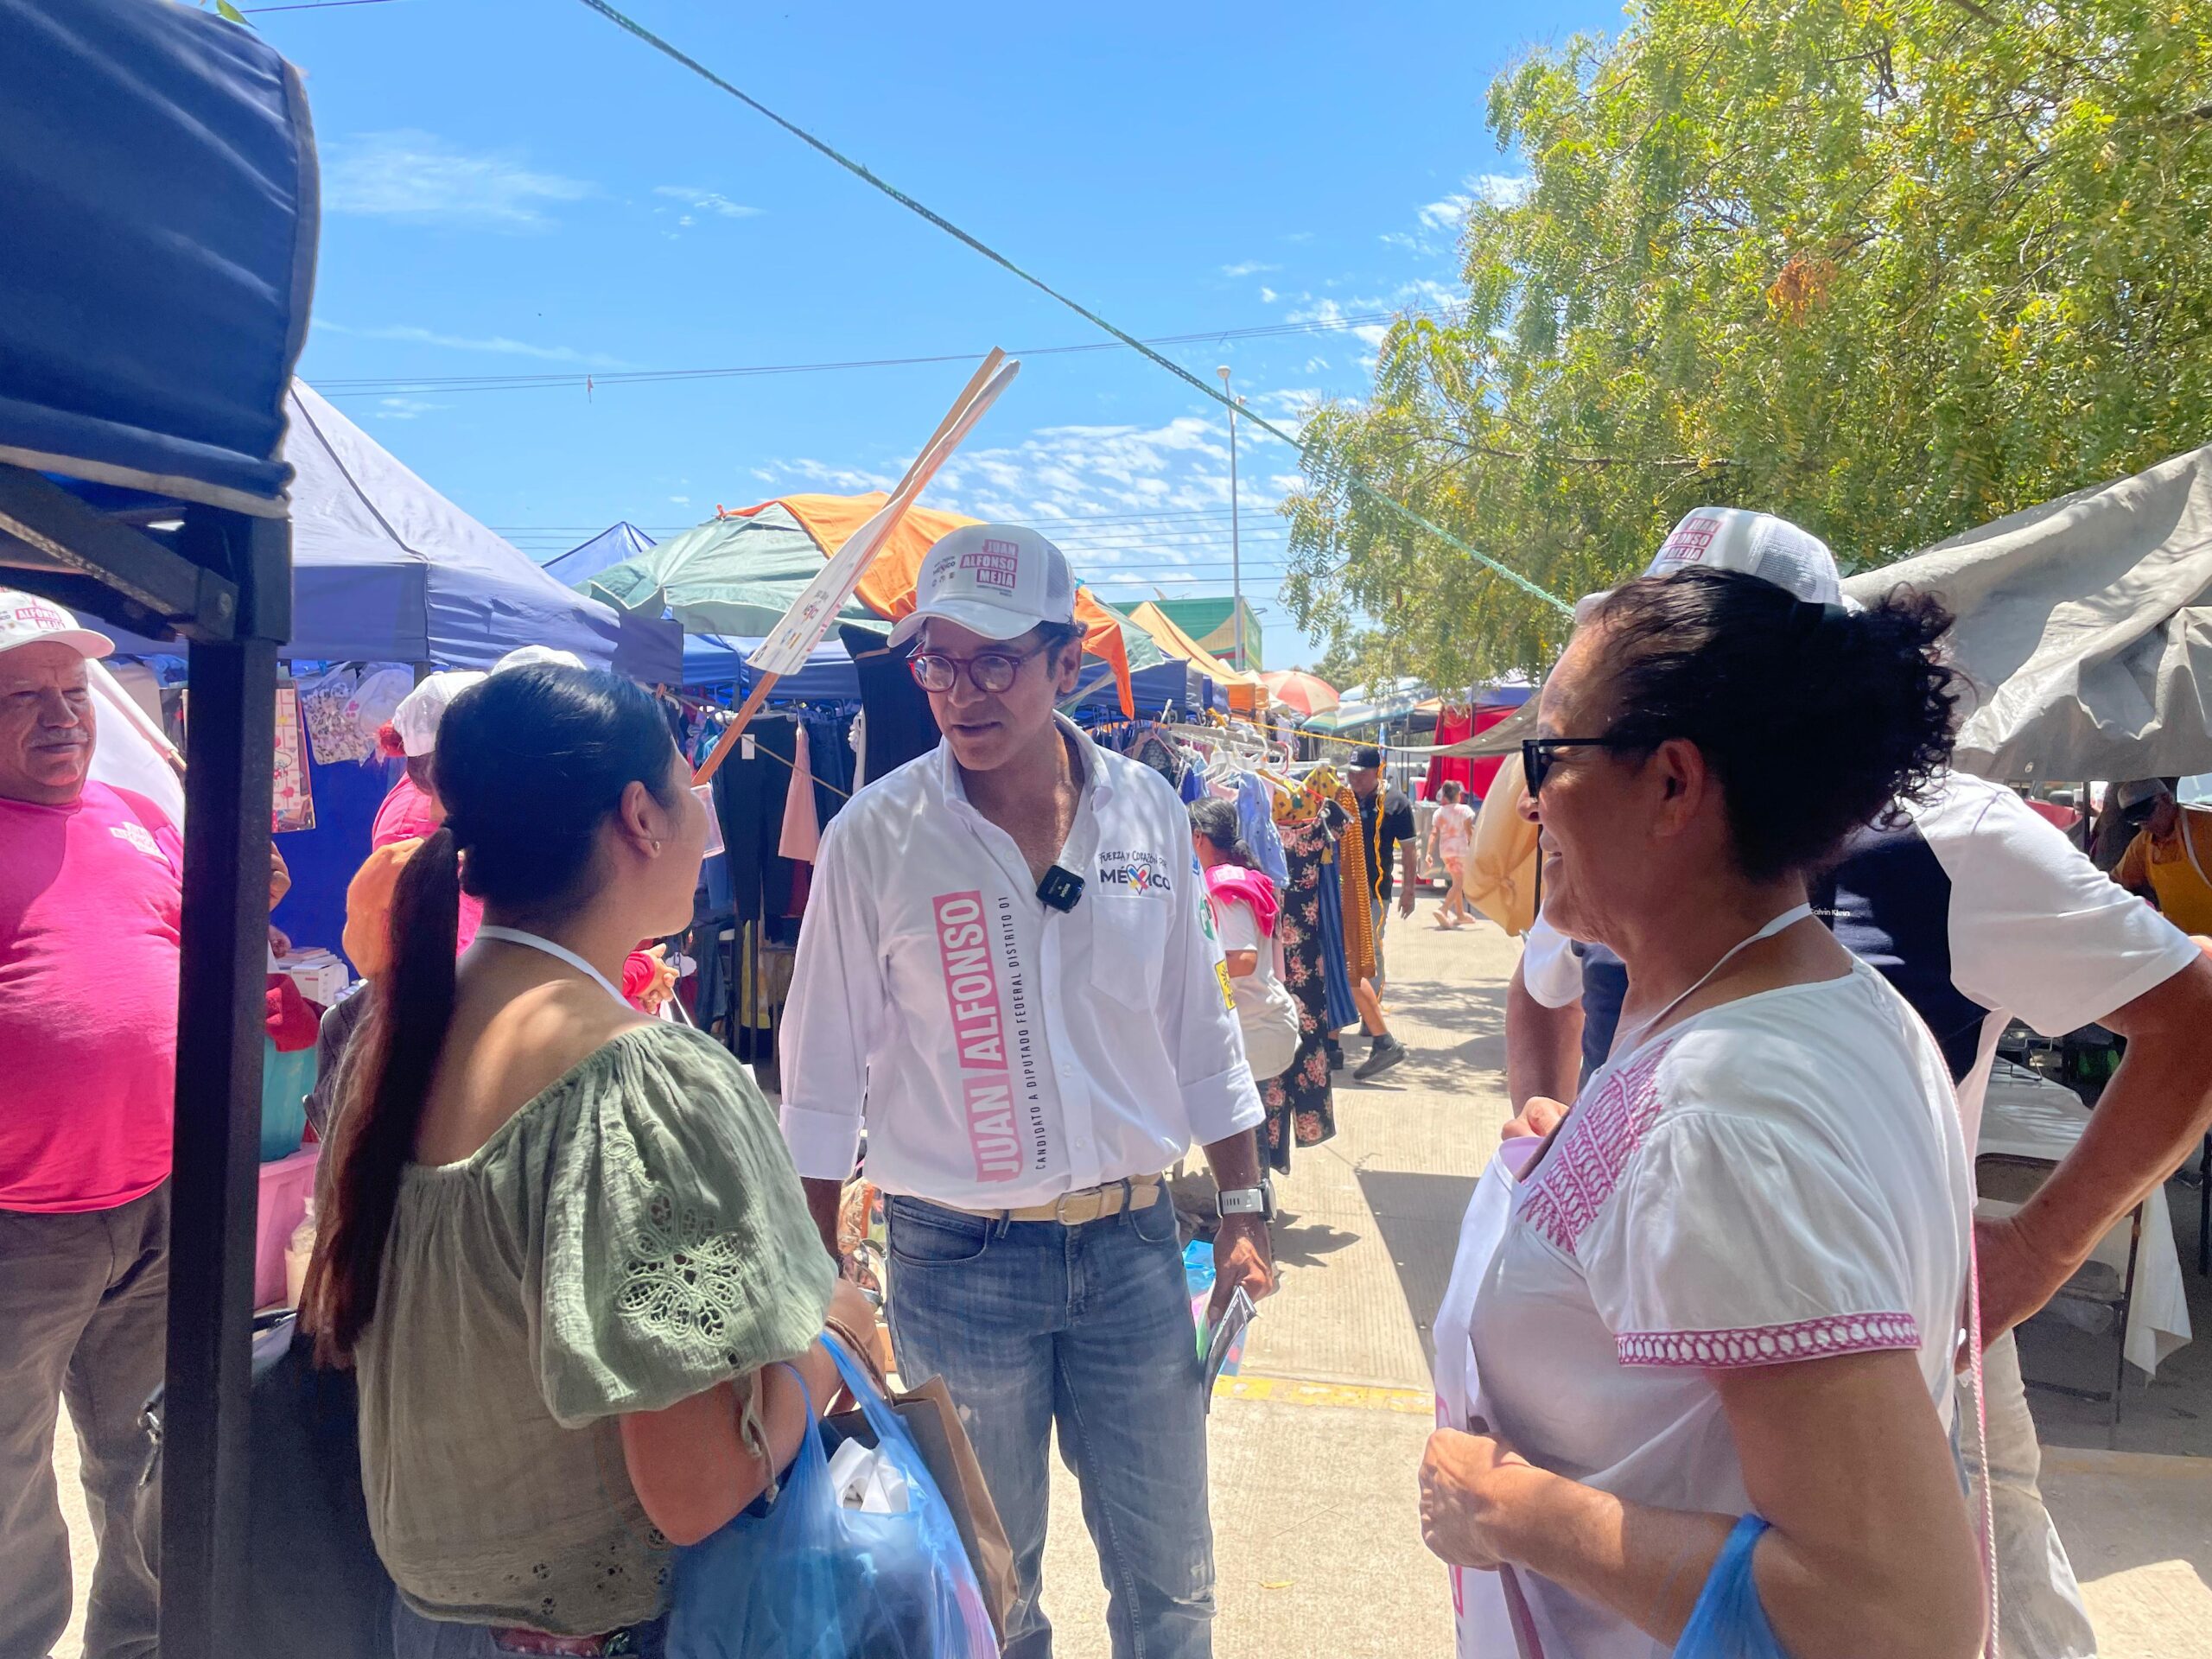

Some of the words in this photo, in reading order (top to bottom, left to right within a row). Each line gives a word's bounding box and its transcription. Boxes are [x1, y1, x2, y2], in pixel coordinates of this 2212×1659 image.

[963, 553, 1015, 571] ALFONSO
[986, 540, 1016, 556] JUAN
[1098, 851, 1126, 864] FUERZA
[1099, 864, 1171, 894] MÉXICO
[1001, 914, 1020, 968] DISTRITO
[939, 899, 1002, 1062] ALFONSO
[1011, 973, 1027, 1024] FEDERAL
[1018, 1029, 1038, 1088] DIPUTADO
[969, 1084, 1020, 1173] JUAN
[1030, 1106, 1046, 1170] CANDIDATO
